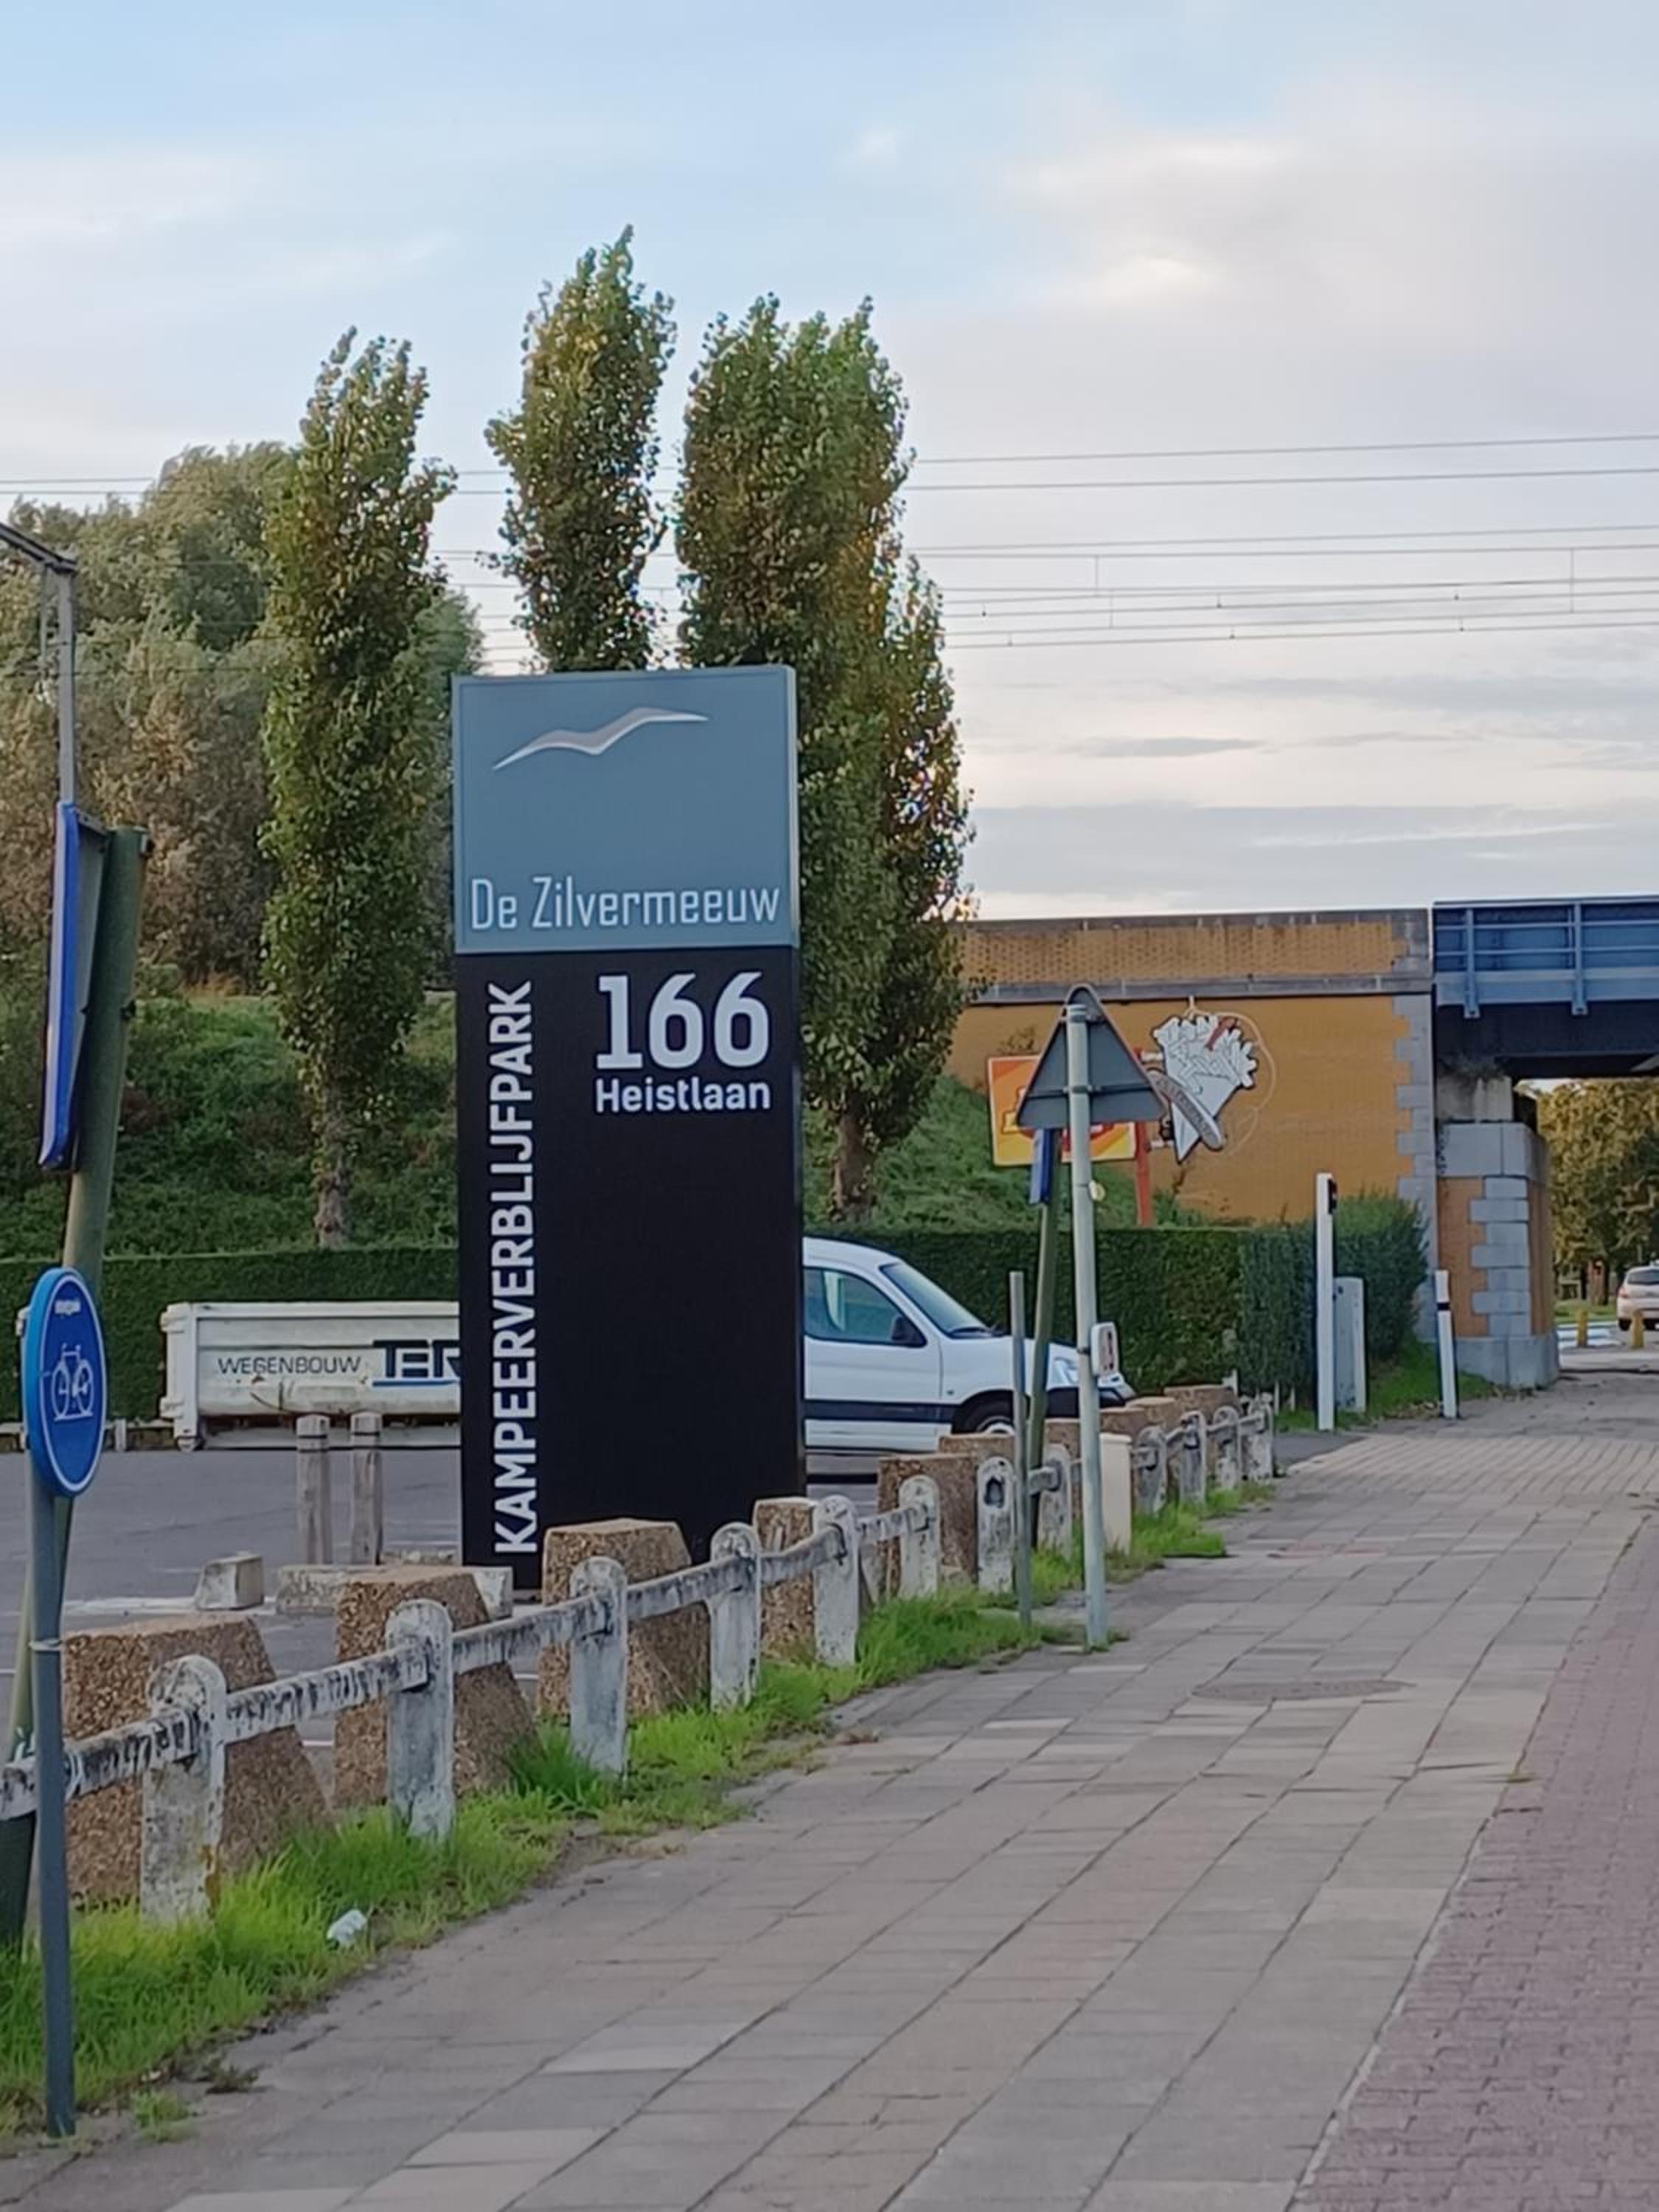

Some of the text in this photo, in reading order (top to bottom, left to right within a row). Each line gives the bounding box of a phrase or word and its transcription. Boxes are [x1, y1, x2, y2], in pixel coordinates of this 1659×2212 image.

[470, 875, 779, 930] De Zilvermeeuw
[596, 971, 770, 1069] 166
[595, 1076, 771, 1113] Heistlaan
[488, 981, 538, 1554] KAMPEERVERBLIJFPARK
[218, 1355, 361, 1374] WEGENBOUW
